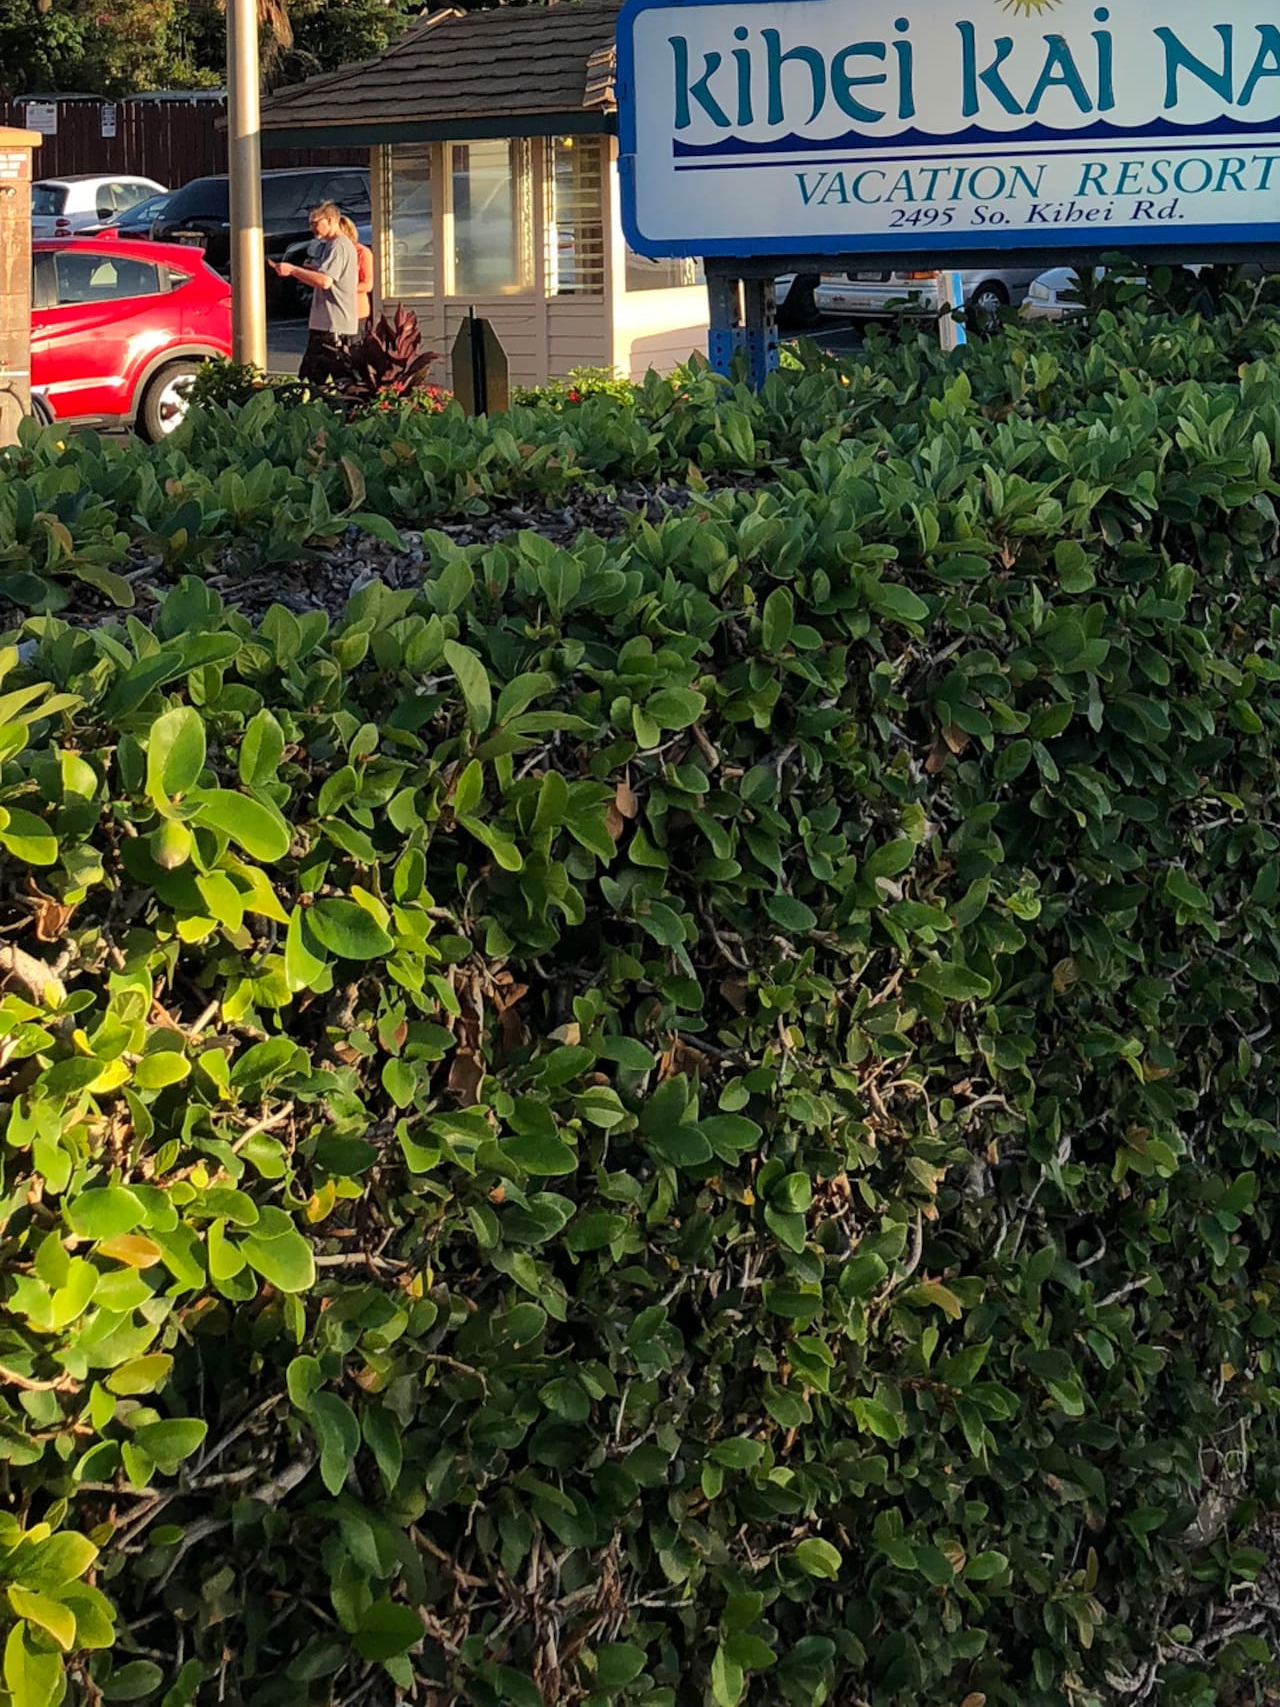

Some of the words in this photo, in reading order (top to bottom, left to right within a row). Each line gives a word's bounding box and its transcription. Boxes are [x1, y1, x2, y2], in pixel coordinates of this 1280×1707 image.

[794, 164, 1048, 206] VACATION
[888, 207, 956, 228] 2495
[970, 204, 1011, 225] So.
[1024, 201, 1115, 224] Kihei
[1129, 198, 1186, 220] Rd.
